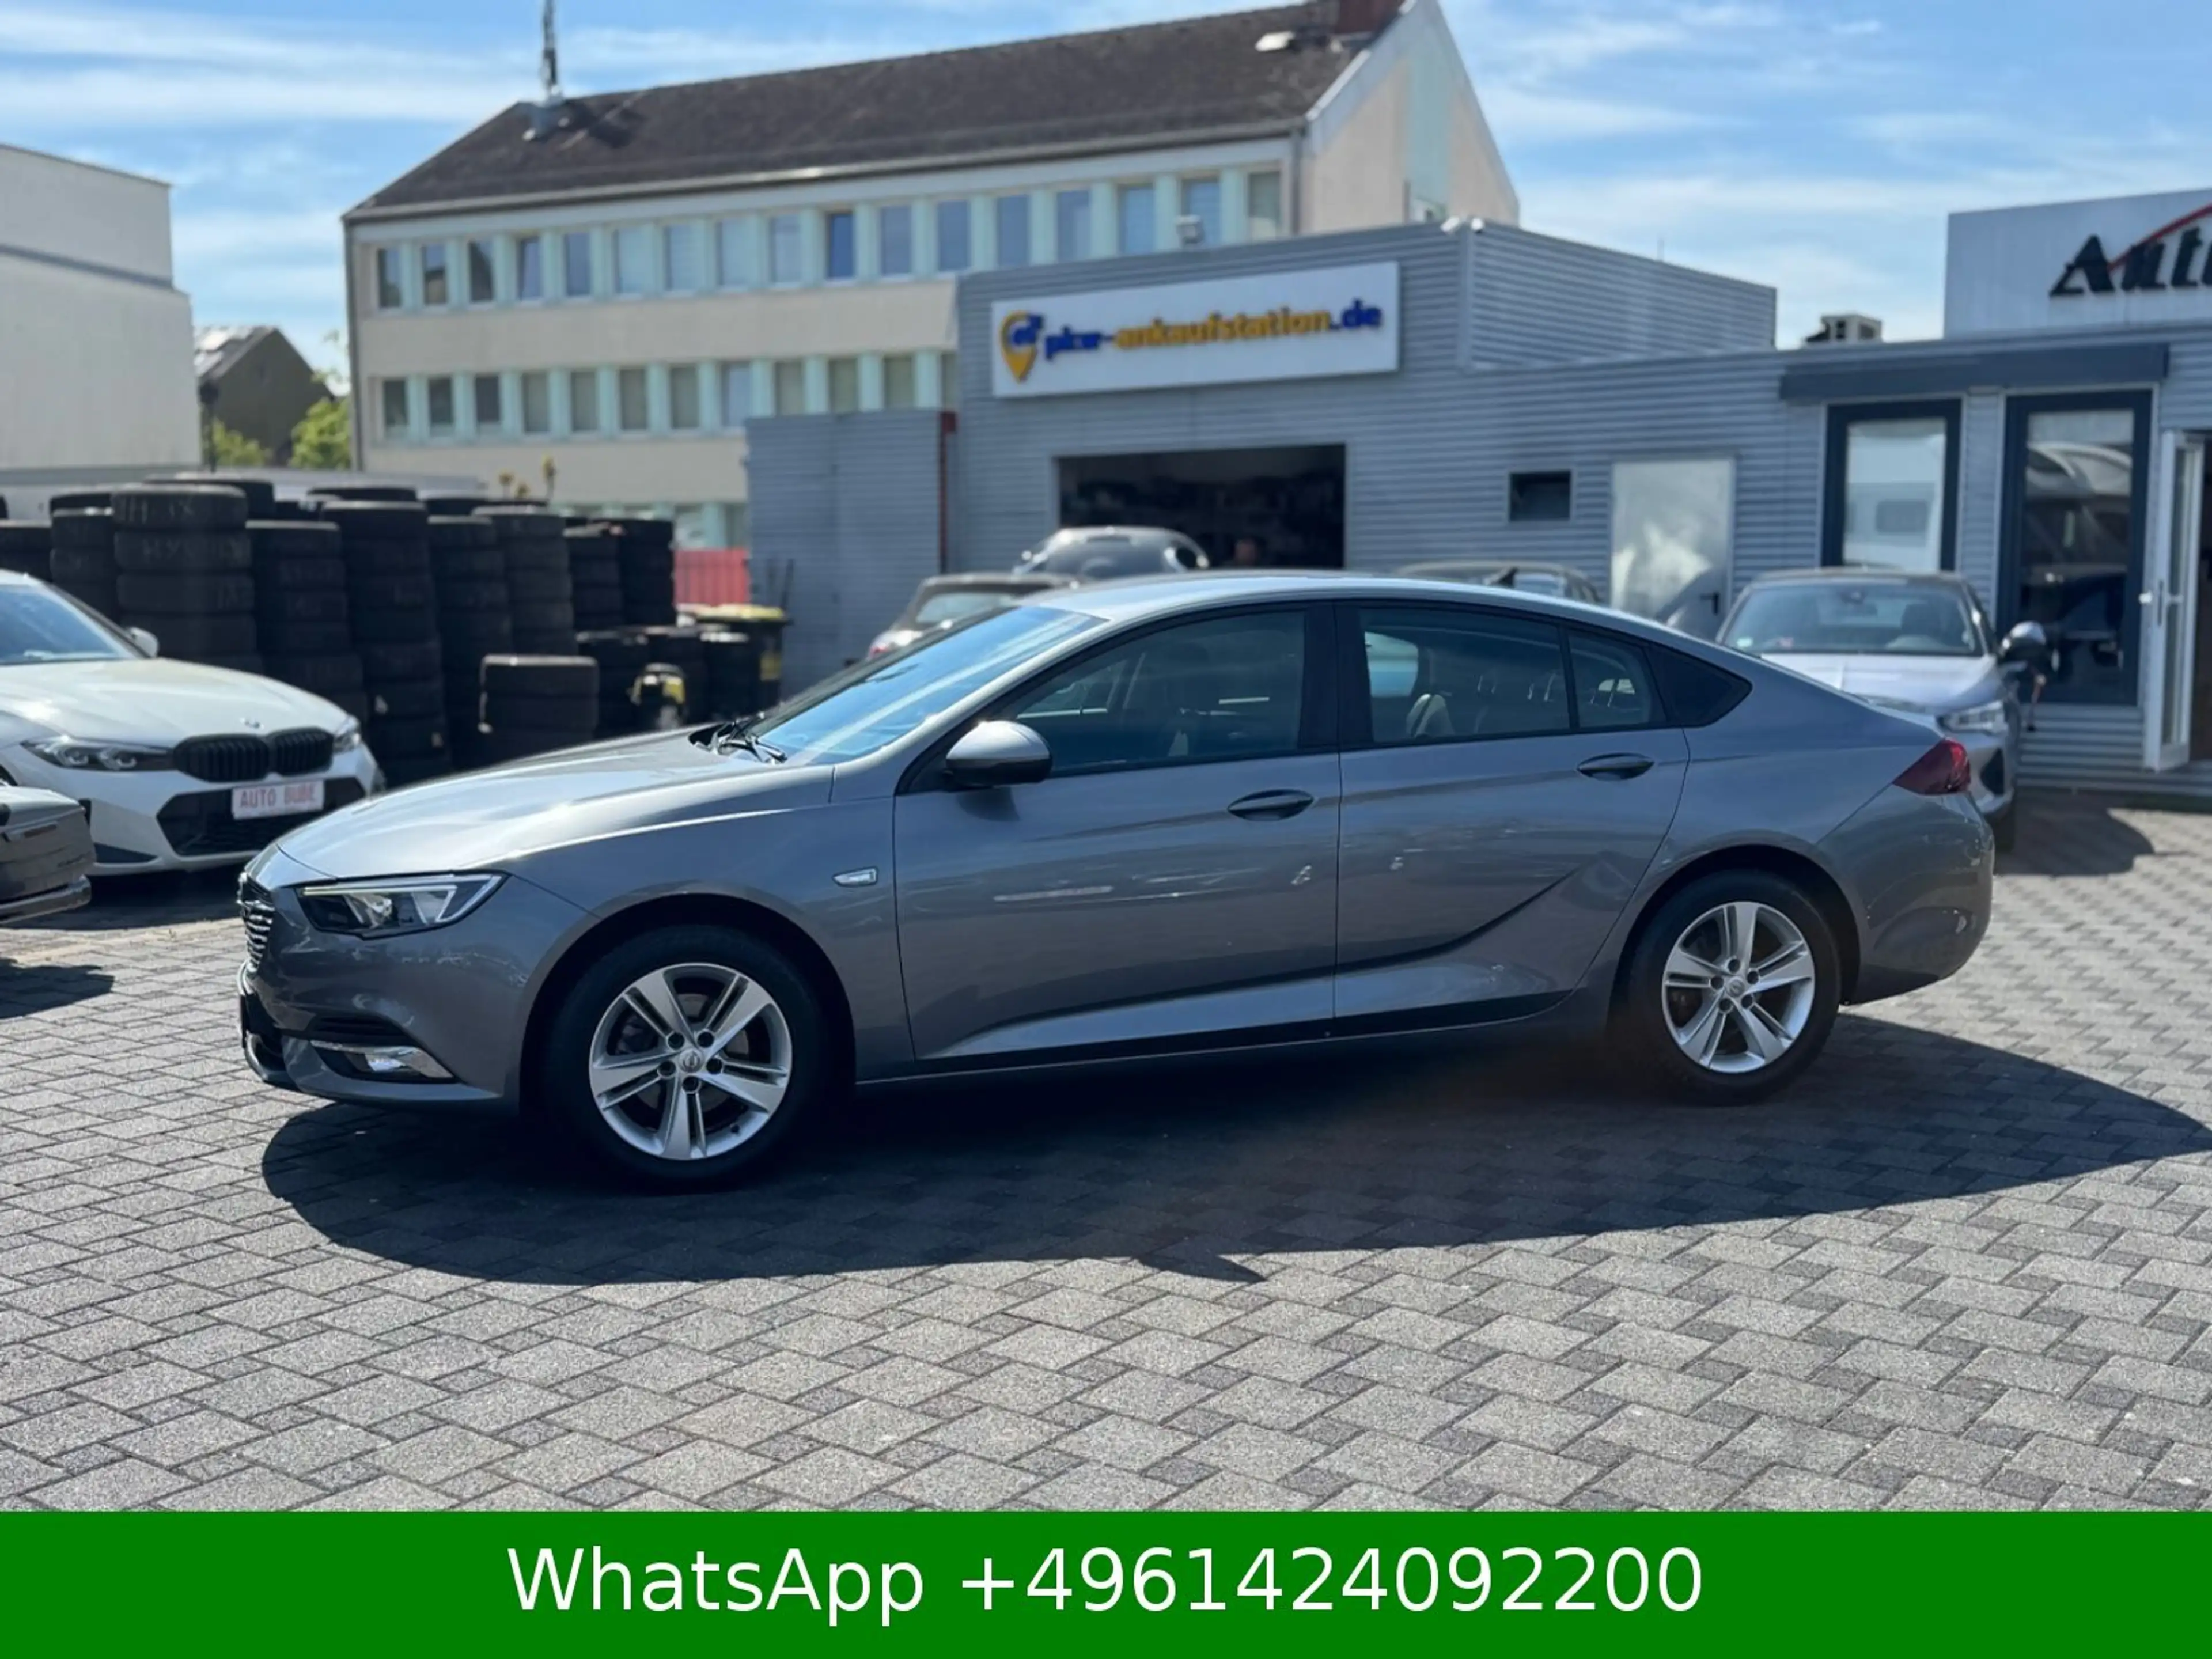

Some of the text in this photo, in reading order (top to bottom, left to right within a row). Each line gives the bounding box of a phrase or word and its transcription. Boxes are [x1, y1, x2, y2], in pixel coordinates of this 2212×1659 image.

[2048, 226, 2212, 297] Aut
[1044, 298, 1382, 360] pkw-ankaufstation.de
[240, 788, 276, 808] AUTO
